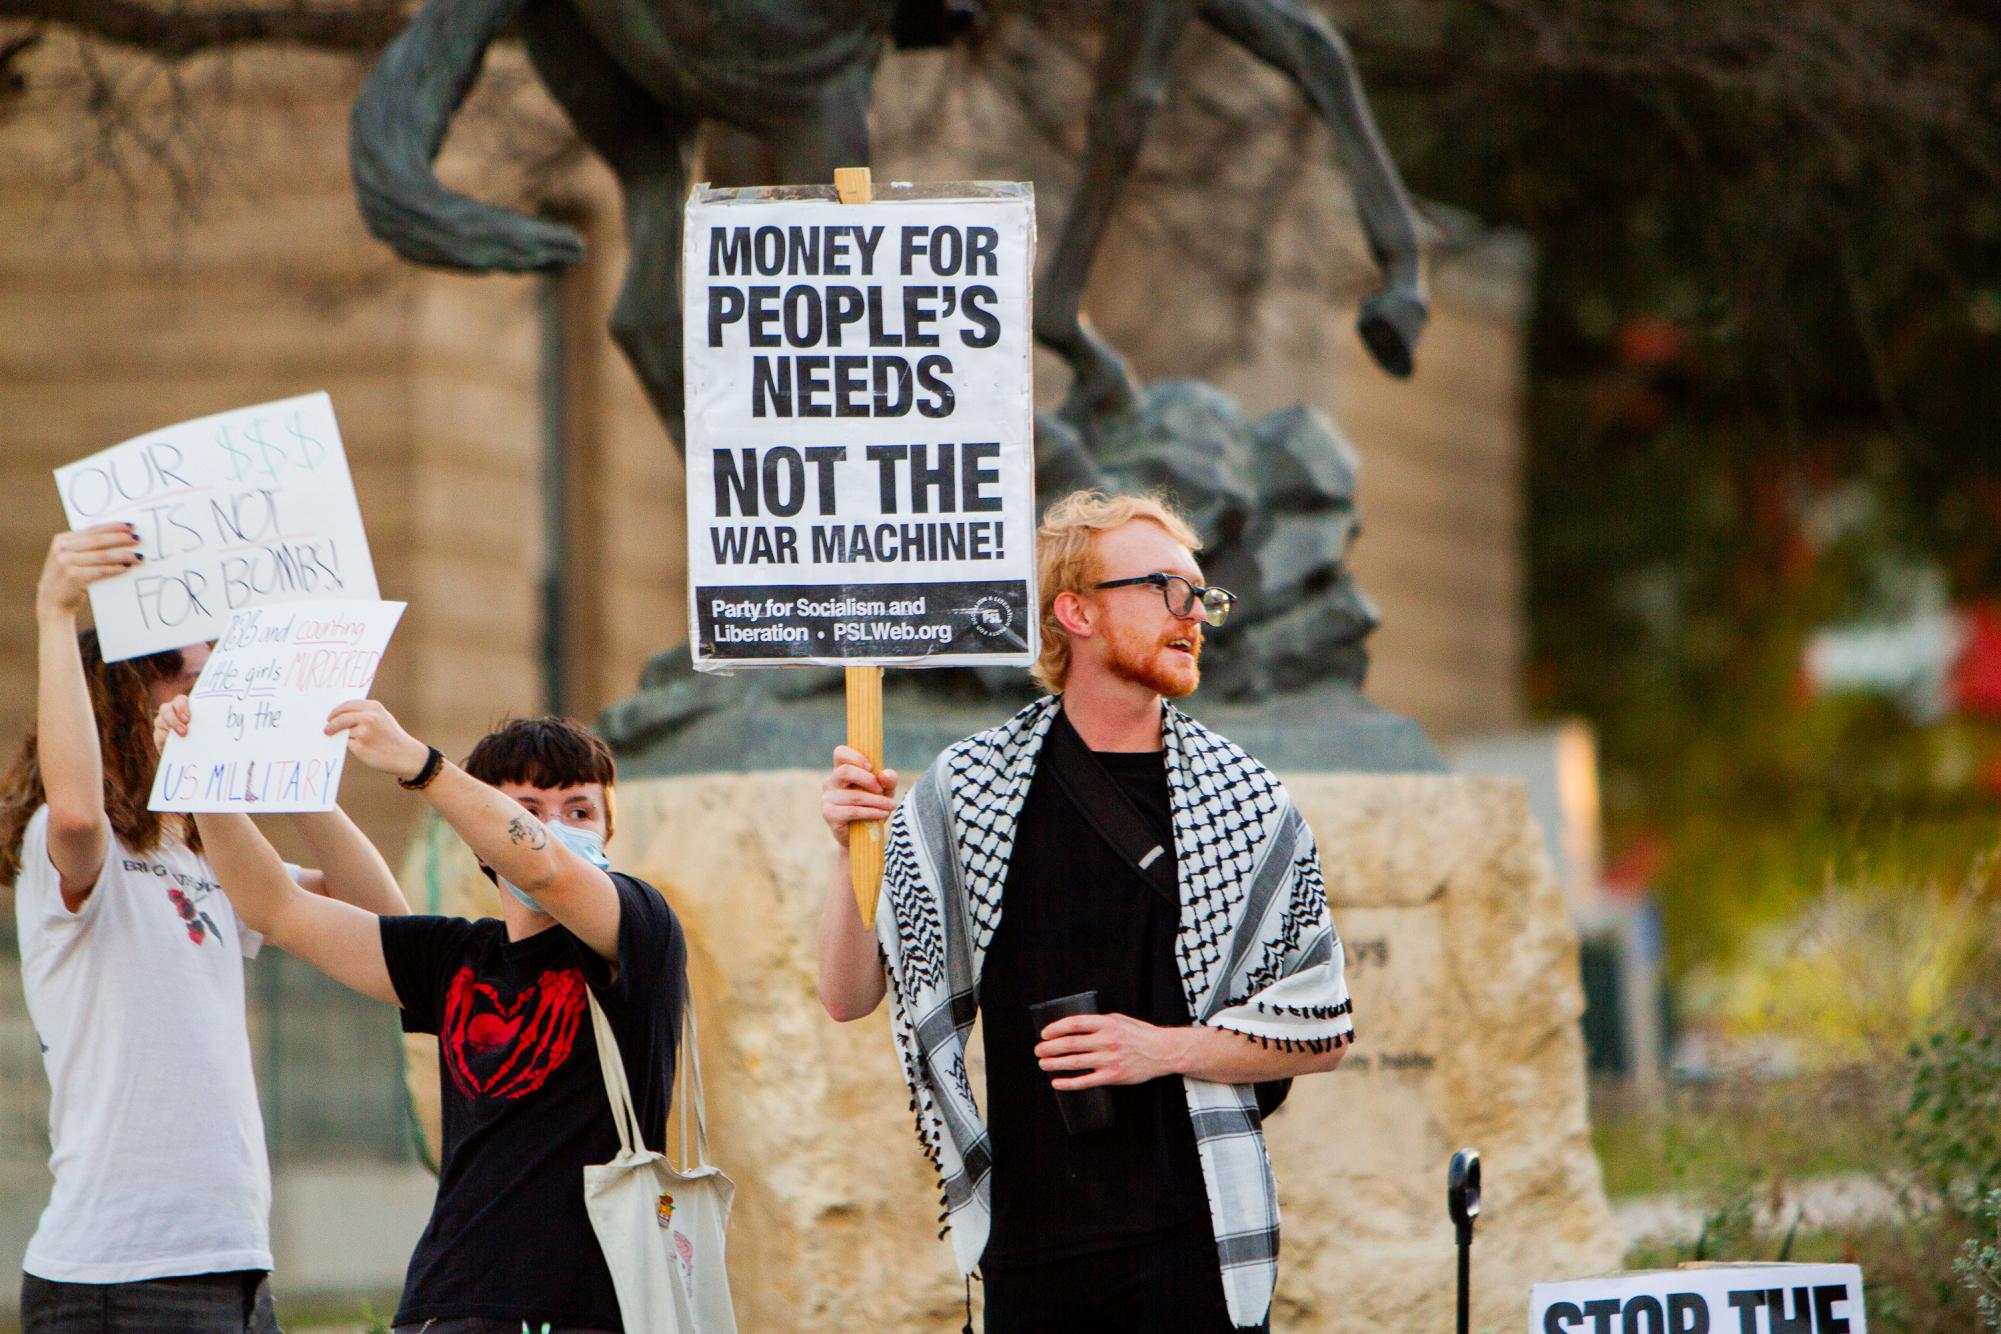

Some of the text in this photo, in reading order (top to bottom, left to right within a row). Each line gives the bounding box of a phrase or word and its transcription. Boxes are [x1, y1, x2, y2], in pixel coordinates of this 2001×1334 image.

[708, 225, 999, 277] MONEY FOR
[708, 284, 1001, 348] PEOPLE'S
[752, 355, 955, 418] NEEDS
[69, 442, 193, 517] OUR
[712, 442, 1003, 518] NOT THE
[140, 488, 284, 562] IS NOT
[710, 521, 1005, 565] WAR MACHINE!
[134, 538, 344, 630] FOR BOMBS!
[259, 612, 297, 644] and
[295, 612, 366, 646] counting
[712, 597, 926, 622] Party for Socialism and
[714, 622, 952, 643] Liberation PSLWeb.org
[244, 657, 283, 701] girls
[226, 700, 282, 741] by the
[163, 762, 199, 801] US
[1543, 1284, 1851, 1334] STOP THE
